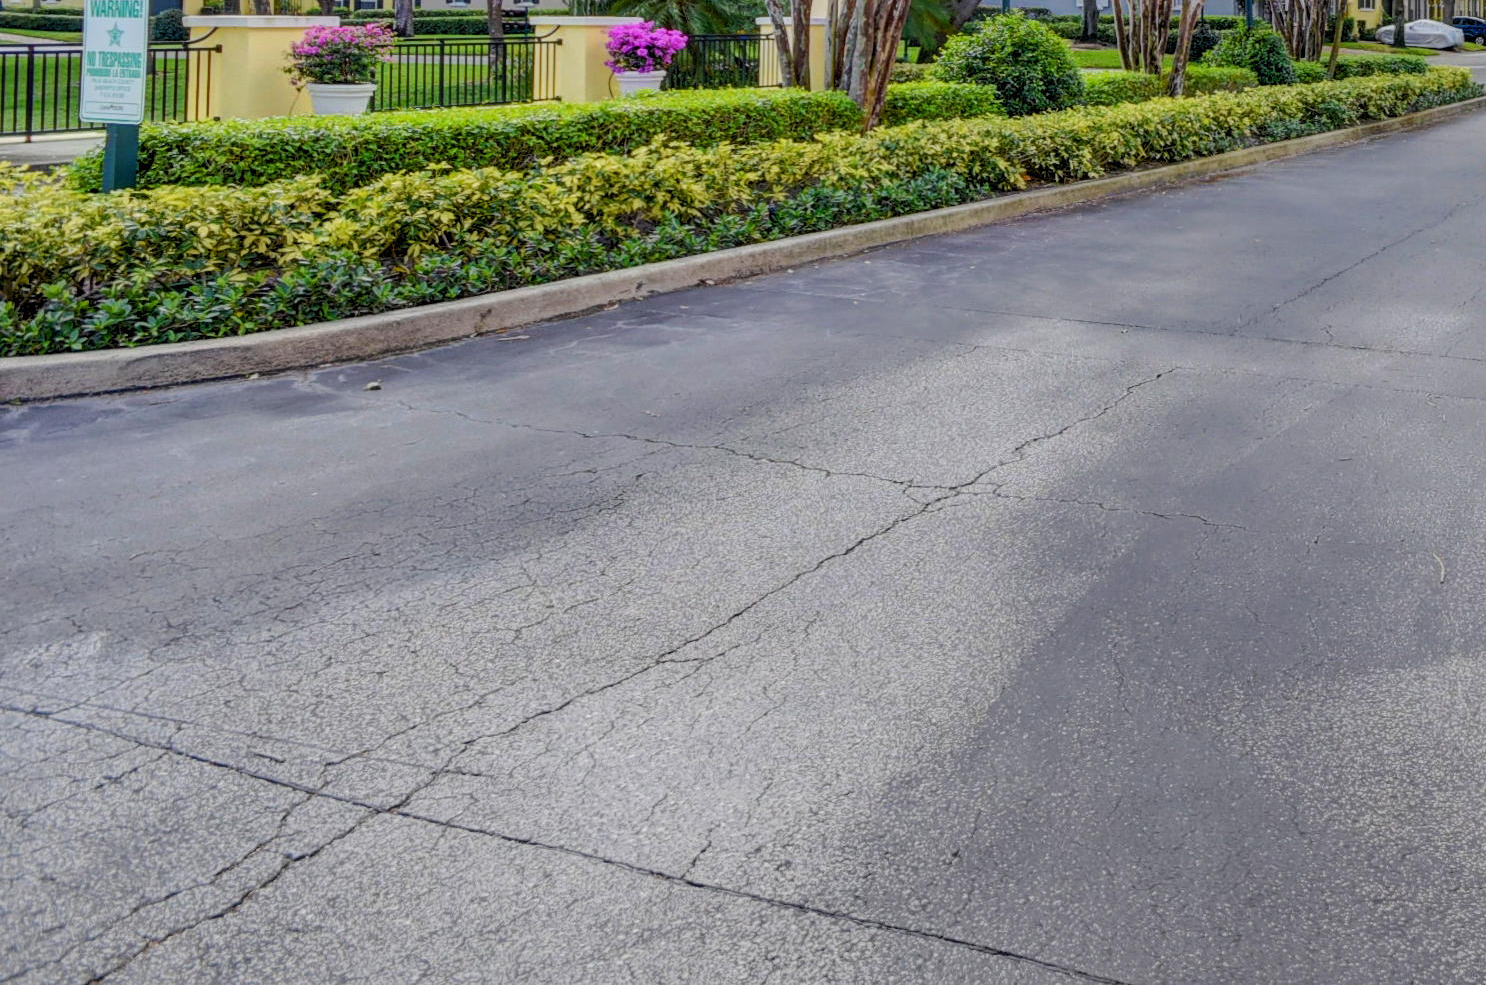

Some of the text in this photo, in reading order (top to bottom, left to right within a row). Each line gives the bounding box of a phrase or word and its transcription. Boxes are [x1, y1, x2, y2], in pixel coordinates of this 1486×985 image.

[90, 0, 143, 18] WARNING!
[87, 51, 142, 68] NO TRESPASSING
